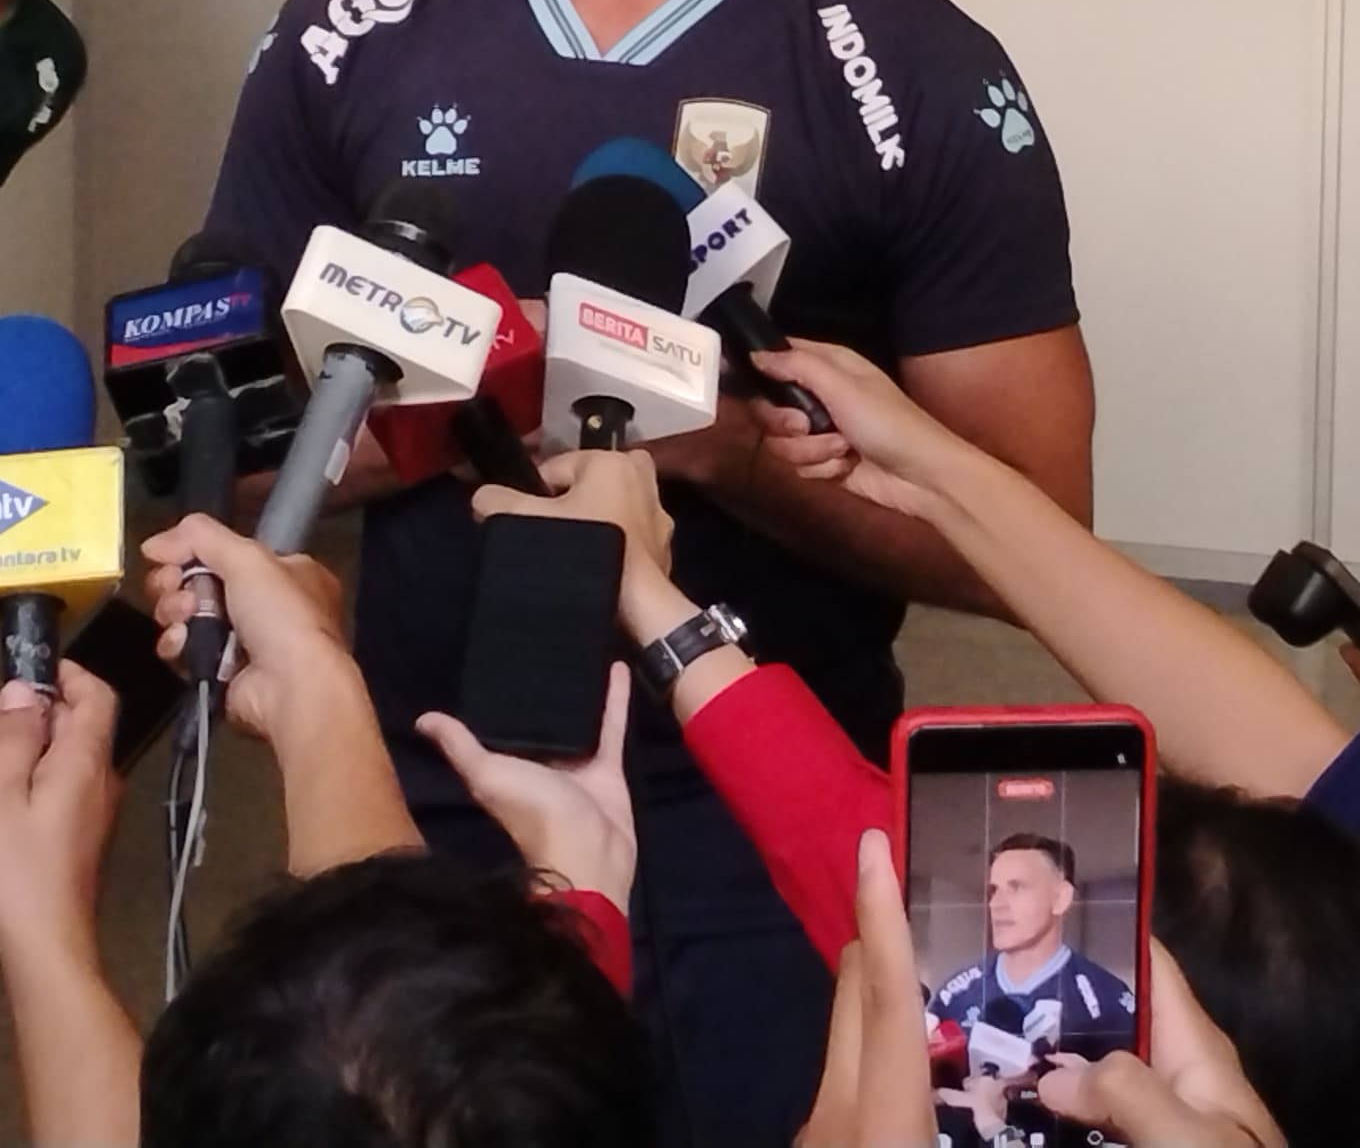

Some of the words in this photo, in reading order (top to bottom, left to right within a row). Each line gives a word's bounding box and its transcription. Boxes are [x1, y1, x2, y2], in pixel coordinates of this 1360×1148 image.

[817, 3, 906, 171] INDOMILK
[400, 157, 482, 177] KELME
[123, 297, 232, 340] KOMPAS
[441, 316, 482, 346] TV
[581, 307, 646, 349] BERITA
[651, 334, 702, 367] SATU
